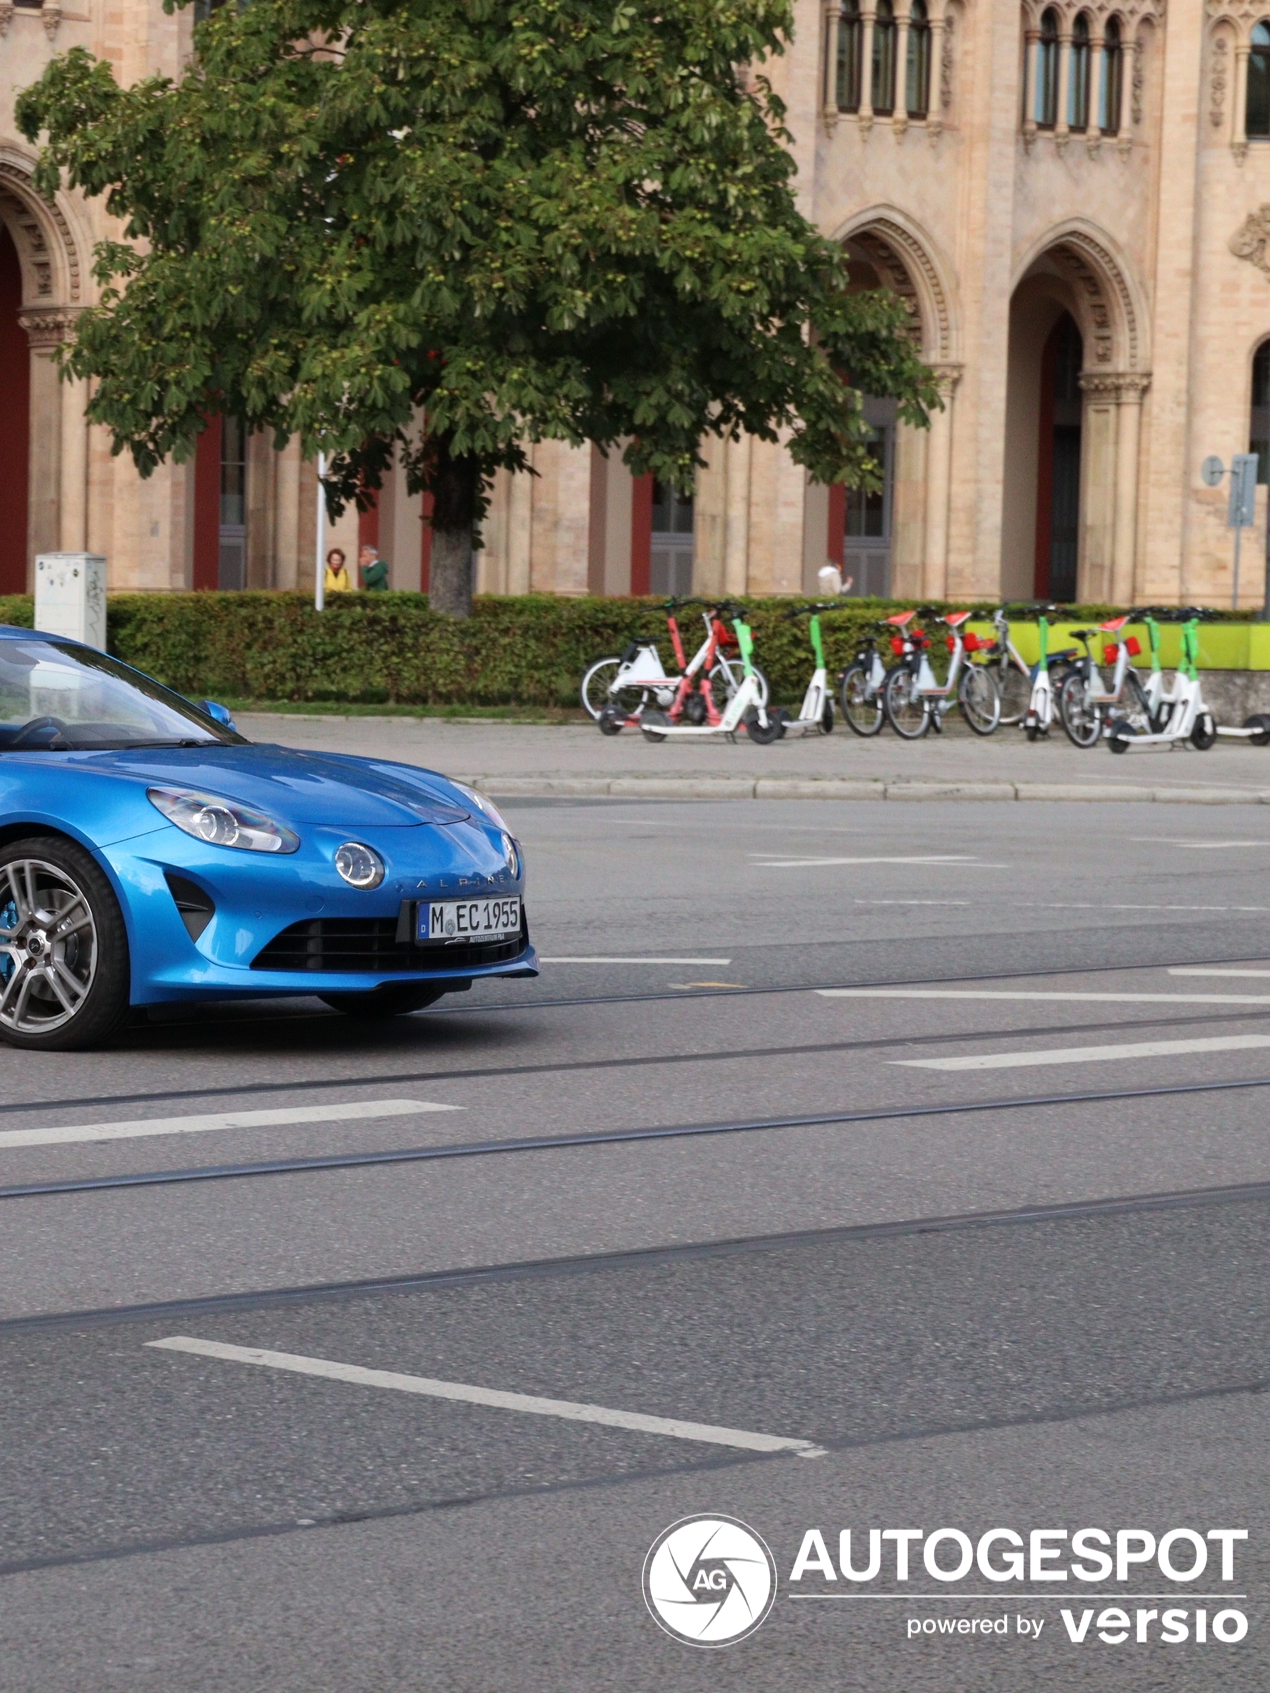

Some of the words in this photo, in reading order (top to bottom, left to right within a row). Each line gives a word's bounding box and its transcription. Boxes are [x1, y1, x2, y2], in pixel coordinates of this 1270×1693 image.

[416, 874, 505, 889] ALPINE
[420, 924, 427, 933] D
[431, 906, 444, 934] M
[456, 904, 480, 933] EC
[483, 900, 518, 931] 1955
